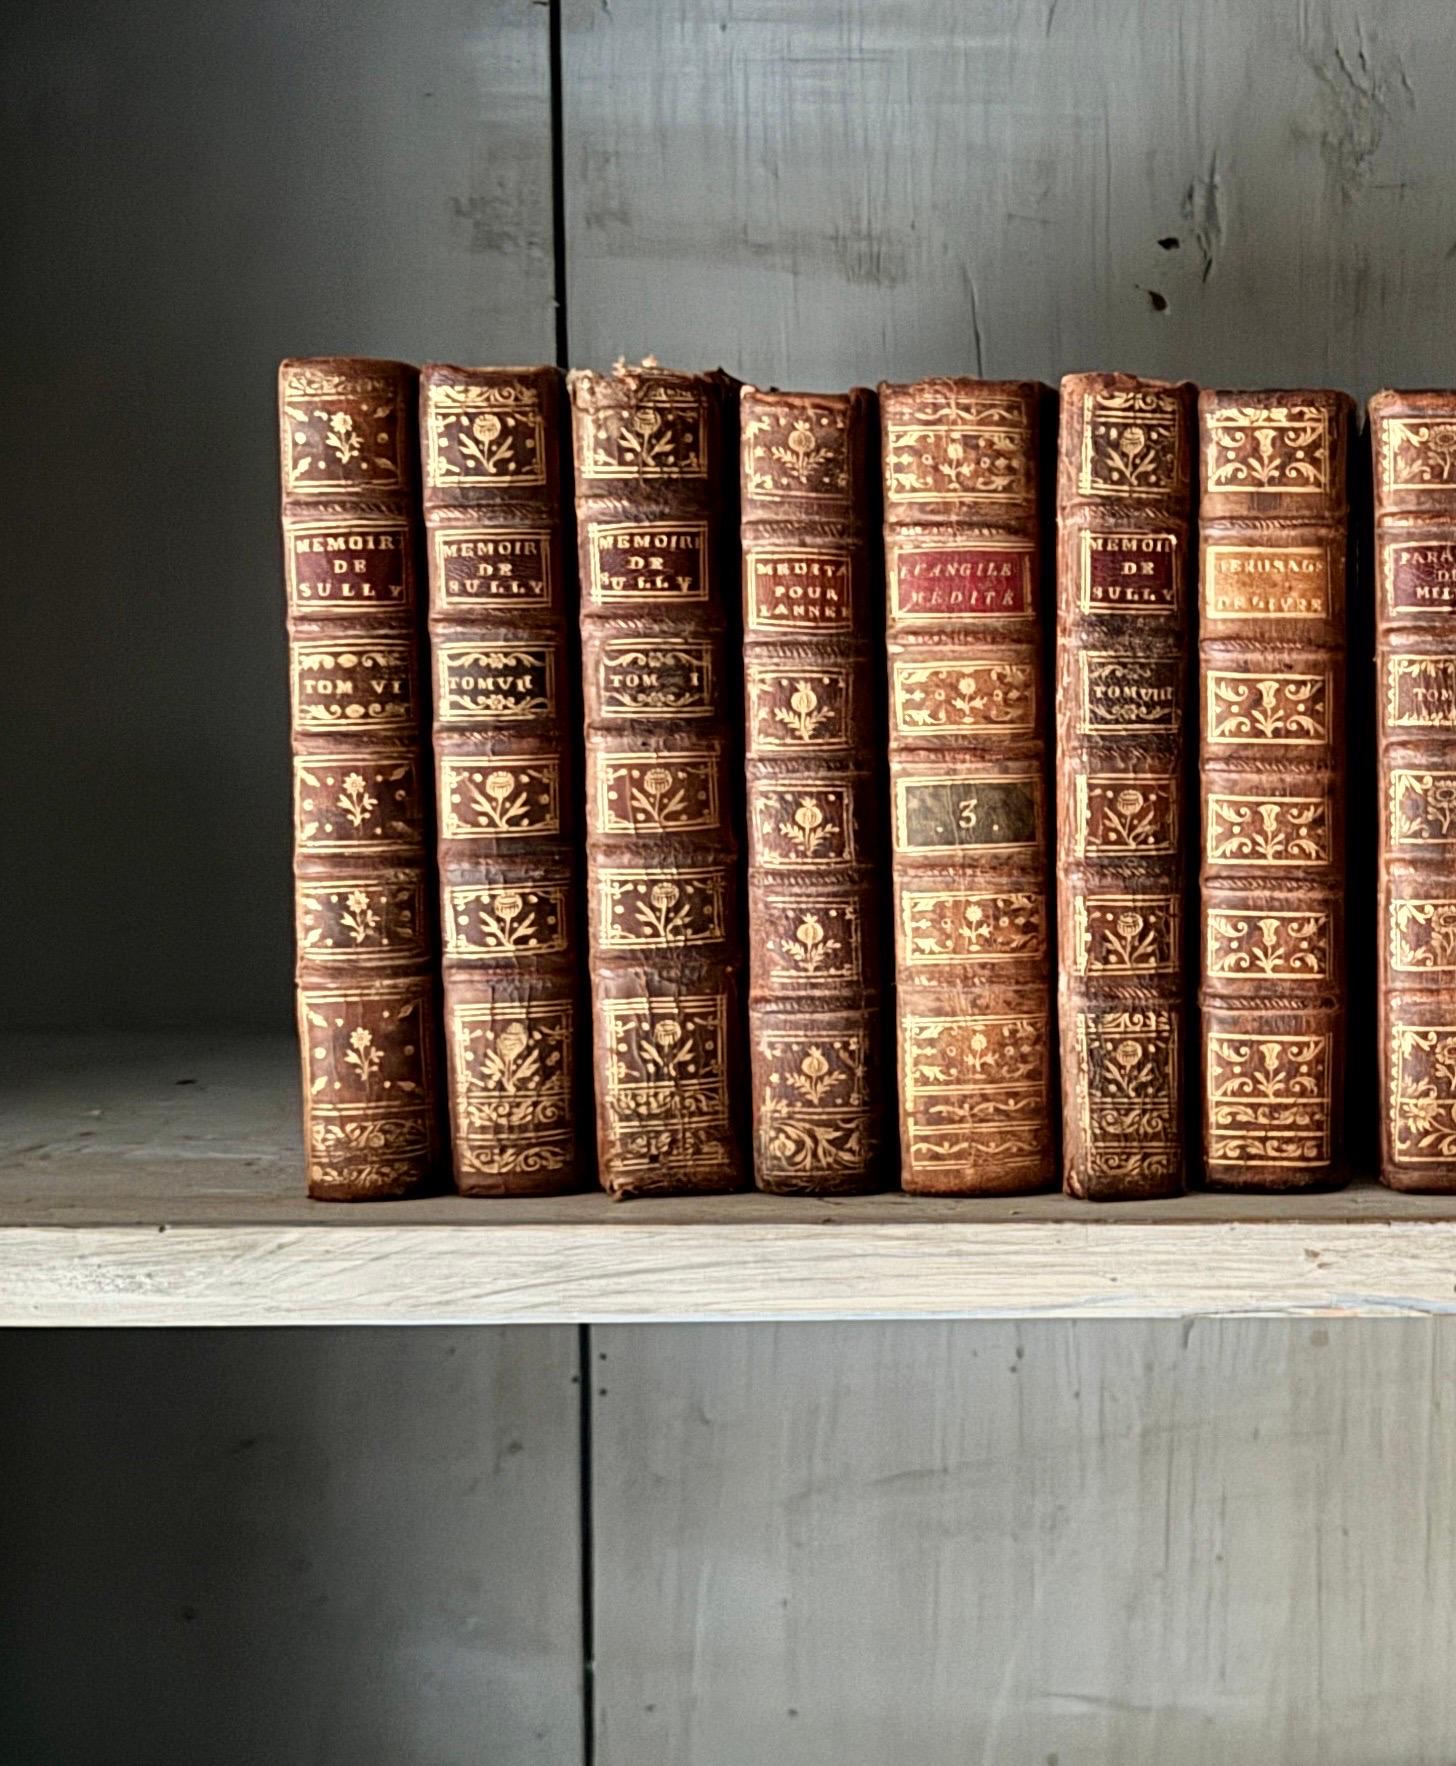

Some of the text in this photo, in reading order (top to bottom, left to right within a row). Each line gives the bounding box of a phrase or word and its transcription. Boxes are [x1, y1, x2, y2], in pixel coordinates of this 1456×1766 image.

[443, 542, 538, 558] MEMOIR
[333, 559, 368, 574] DE
[479, 563, 513, 577] DE
[626, 556, 664, 570] DE
[1120, 561, 1155, 575] DE
[449, 580, 544, 594] SULLY
[600, 571, 692, 592] SULLY
[299, 582, 401, 597] SULLY
[774, 586, 838, 601] POUR
[1092, 586, 1175, 601] SULLY
[303, 679, 354, 695] TOM
[611, 673, 658, 687] TOM
[1412, 687, 1454, 702] TOM
[958, 798, 977, 828] 3
